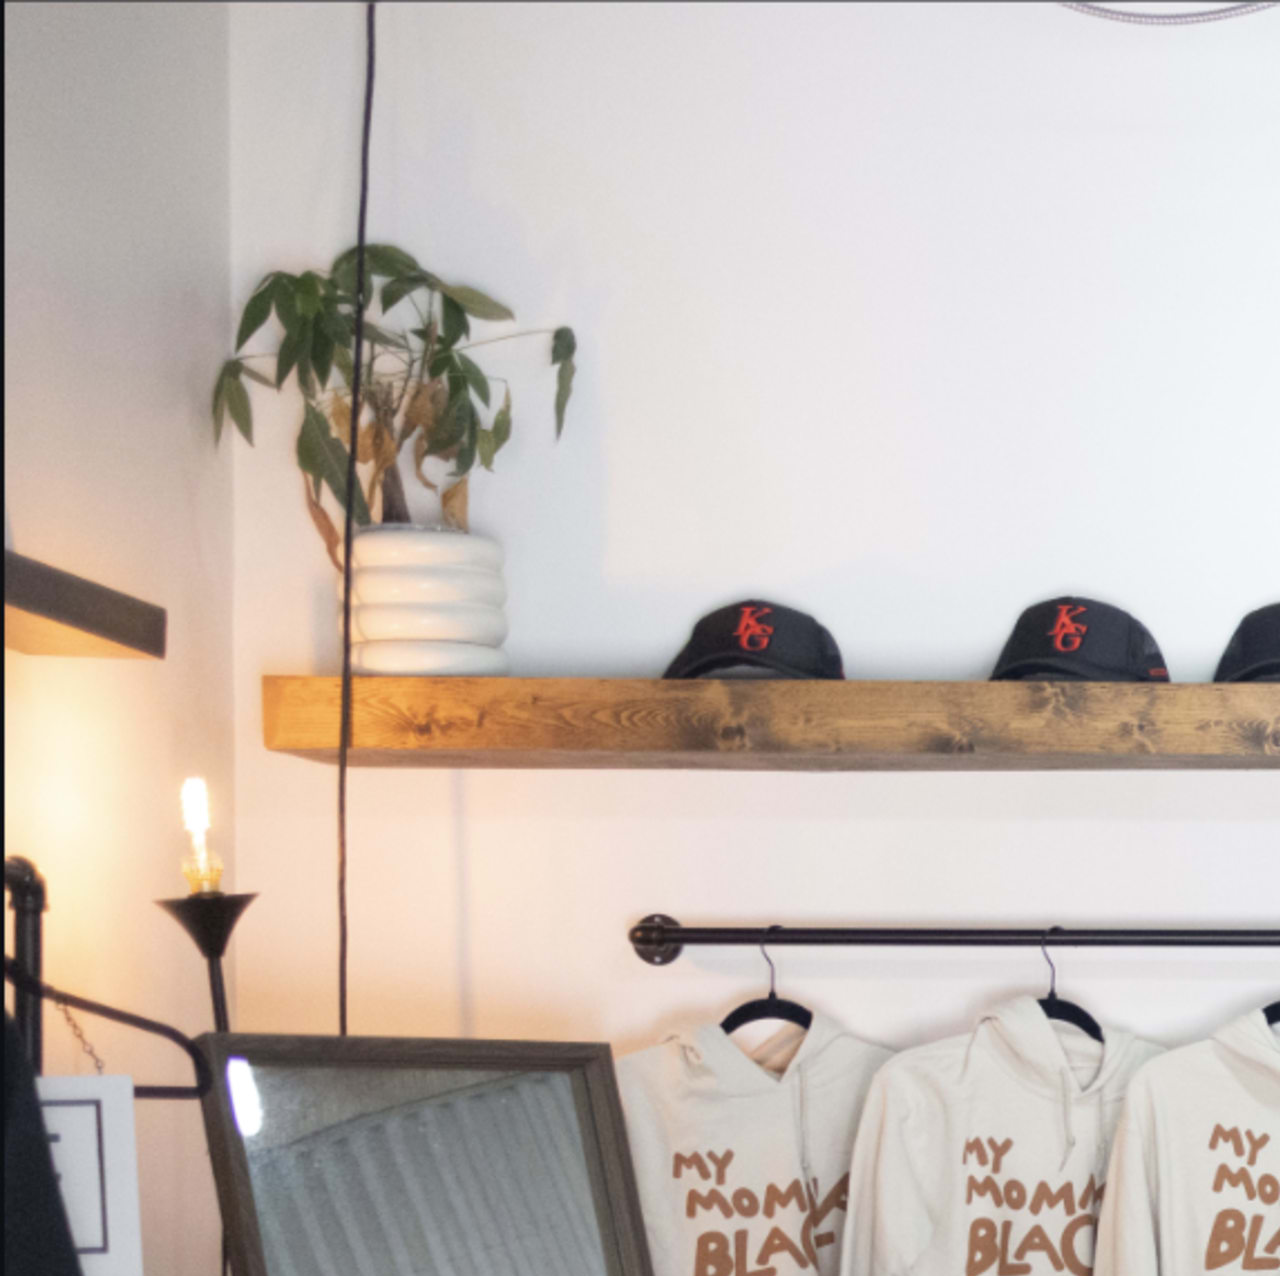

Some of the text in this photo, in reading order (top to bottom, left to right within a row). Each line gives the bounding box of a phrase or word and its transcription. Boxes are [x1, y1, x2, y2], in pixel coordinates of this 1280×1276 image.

[962, 1136, 1014, 1174] MY
[1208, 1123, 1270, 1166] MY
[672, 1148, 734, 1186] MY
